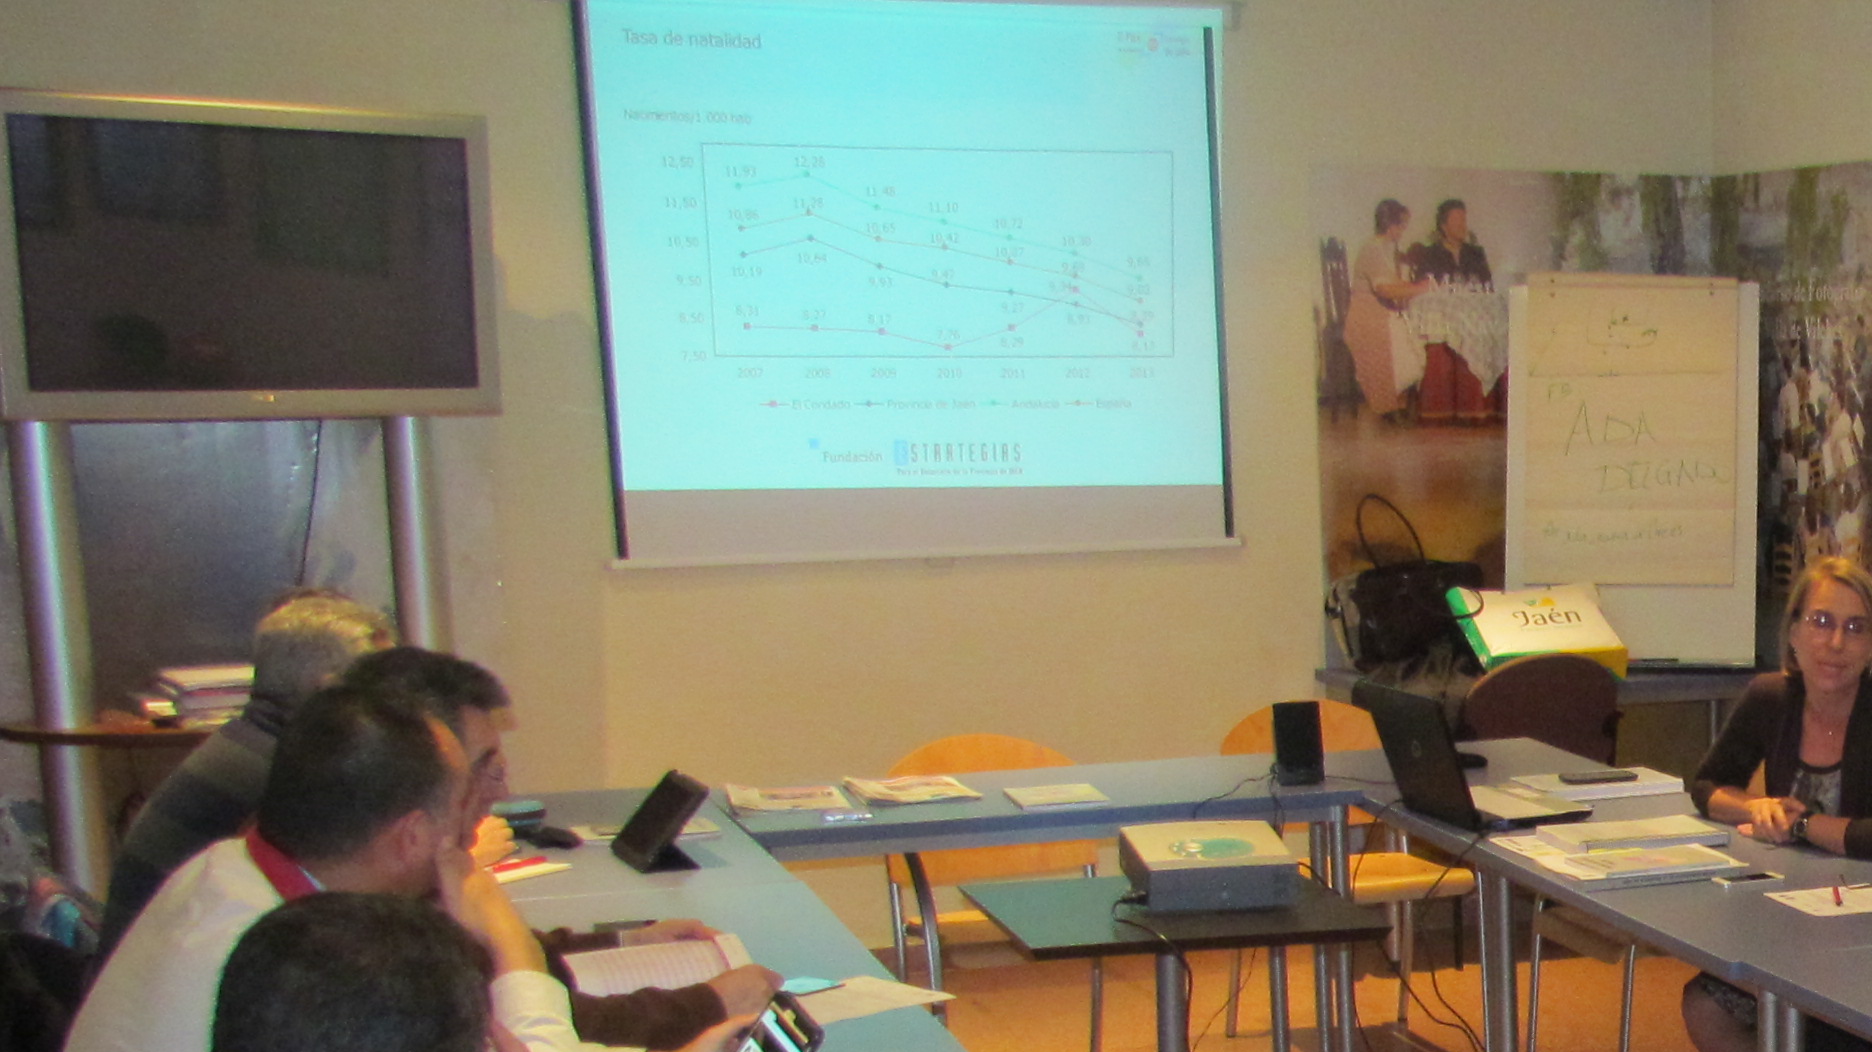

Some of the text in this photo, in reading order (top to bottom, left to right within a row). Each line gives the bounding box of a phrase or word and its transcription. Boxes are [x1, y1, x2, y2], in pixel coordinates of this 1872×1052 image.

[622, 28, 761, 50] Tasa de natalidad
[661, 156, 694, 168] 12,50
[794, 156, 826, 169] 12,28
[725, 165, 757, 178] 11,93
[664, 197, 697, 208] 11,50
[928, 201, 959, 213] 11,10
[866, 222, 896, 234] 10,65
[731, 266, 762, 278] 10,19
[682, 350, 707, 361] 7,50
[737, 368, 763, 379] 2007
[937, 368, 962, 379] 2010
[1001, 368, 1026, 379] 2011
[803, 399, 851, 410] Condado
[822, 450, 884, 464] Fundación
[894, 439, 1022, 465] ESTRATEGIAS
[1512, 607, 1583, 627] Jaén
